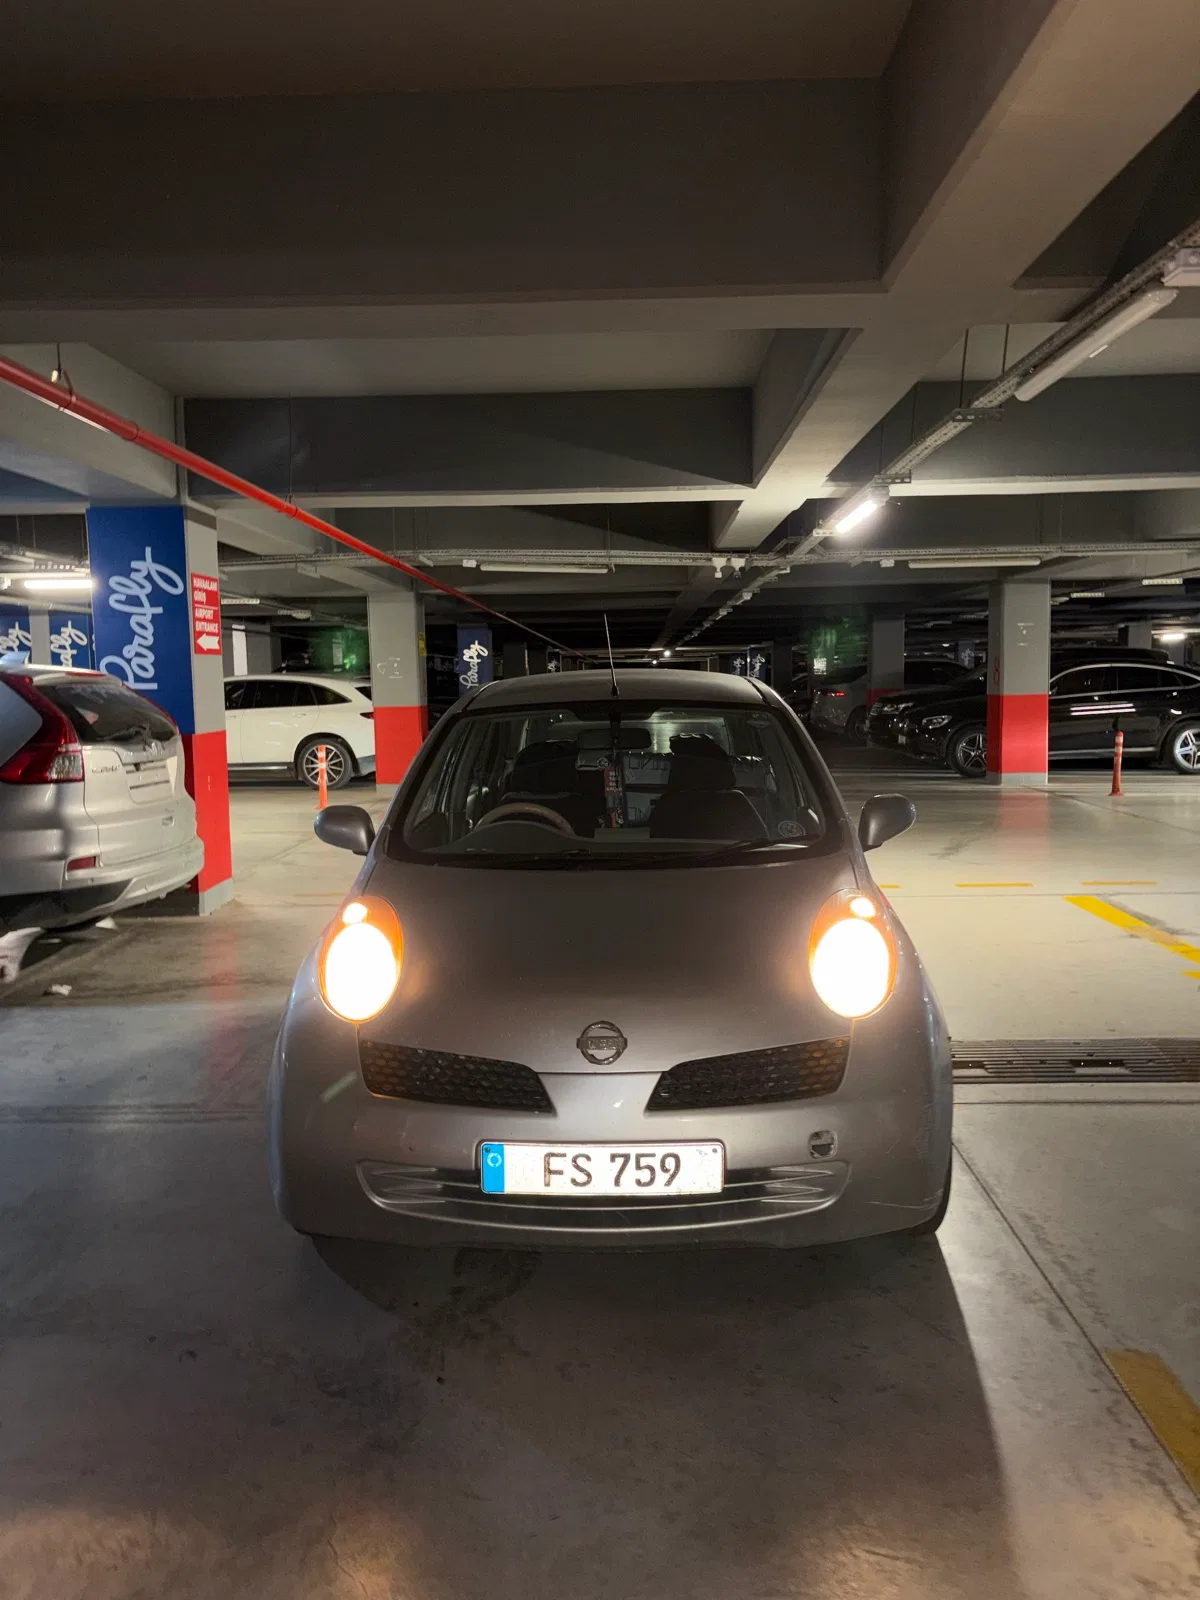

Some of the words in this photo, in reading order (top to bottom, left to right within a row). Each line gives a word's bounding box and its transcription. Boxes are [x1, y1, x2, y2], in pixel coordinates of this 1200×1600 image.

[99, 546, 185, 691] Parafly
[194, 607, 214, 621] AIRPORT
[195, 621, 219, 634] ENTRANCE
[459, 639, 489, 689] Parafly
[543, 1152, 593, 1188] FS
[609, 1152, 681, 1188] 759
